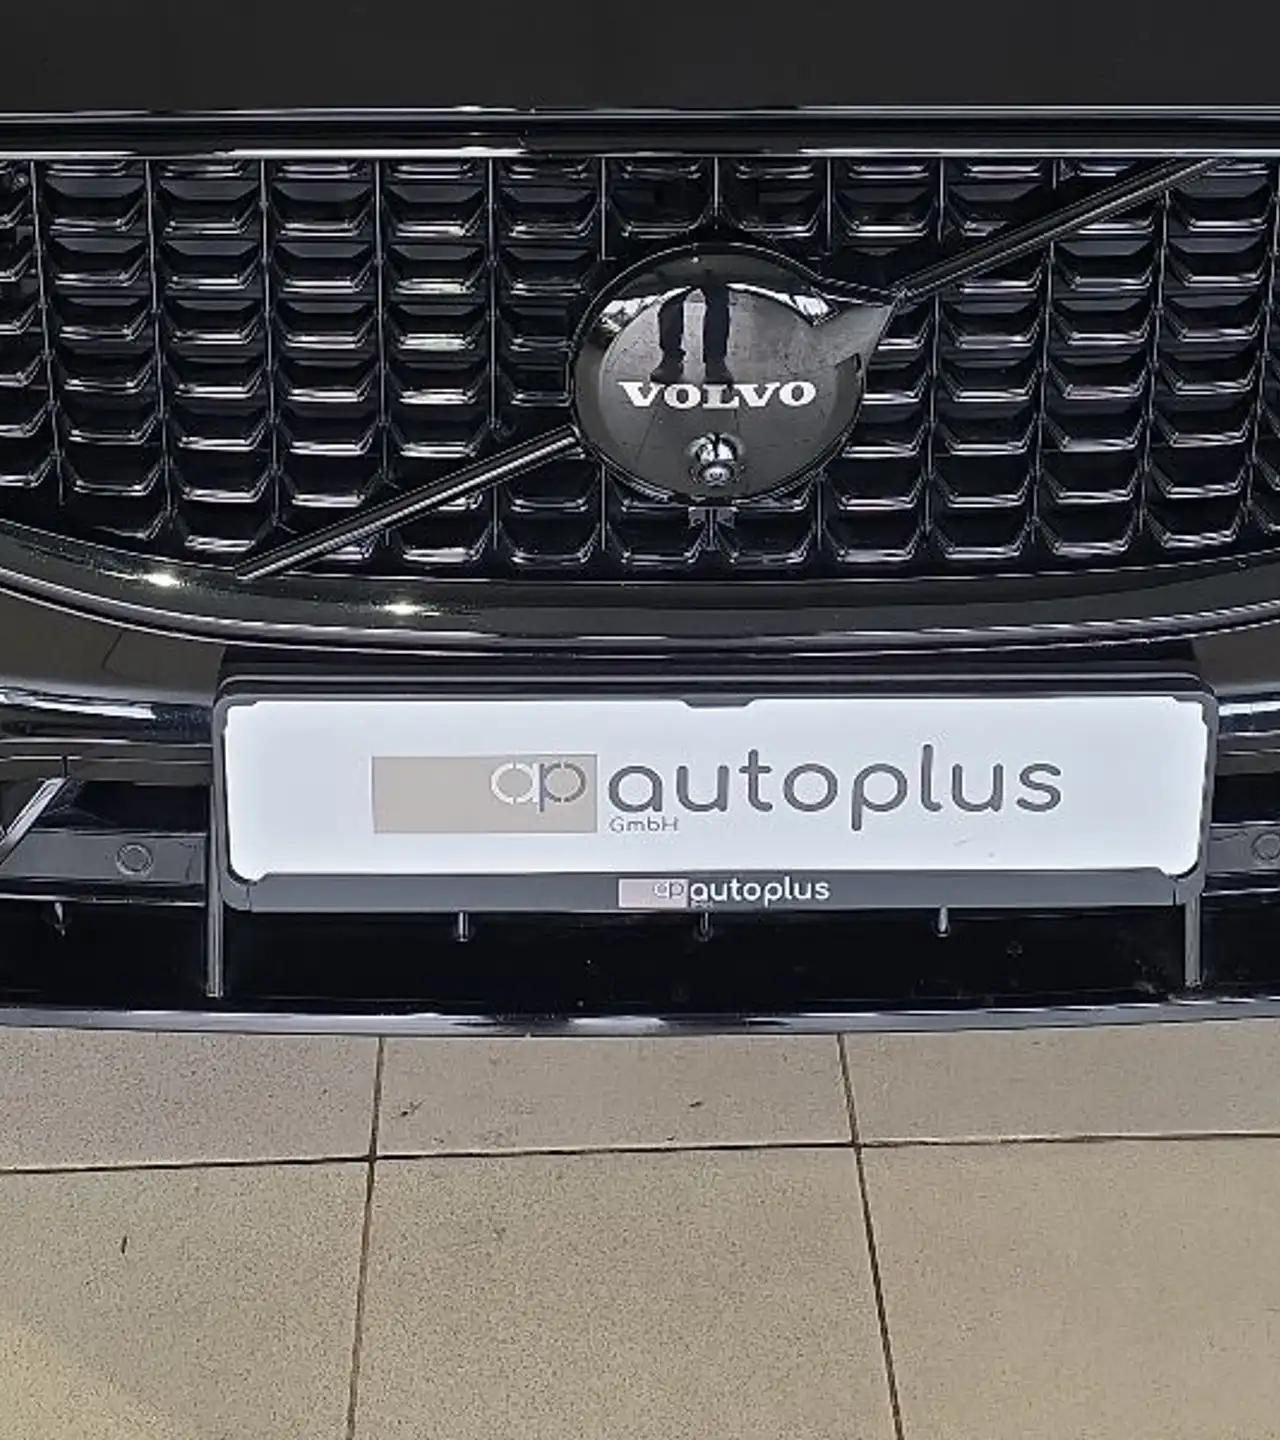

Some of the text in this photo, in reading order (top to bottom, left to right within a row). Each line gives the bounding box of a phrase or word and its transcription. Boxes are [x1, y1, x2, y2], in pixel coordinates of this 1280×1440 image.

[618, 380, 818, 410] VOLVO
[607, 743, 1064, 832] autoplus
[608, 816, 680, 833] GmbH
[689, 875, 832, 909] autoplus
